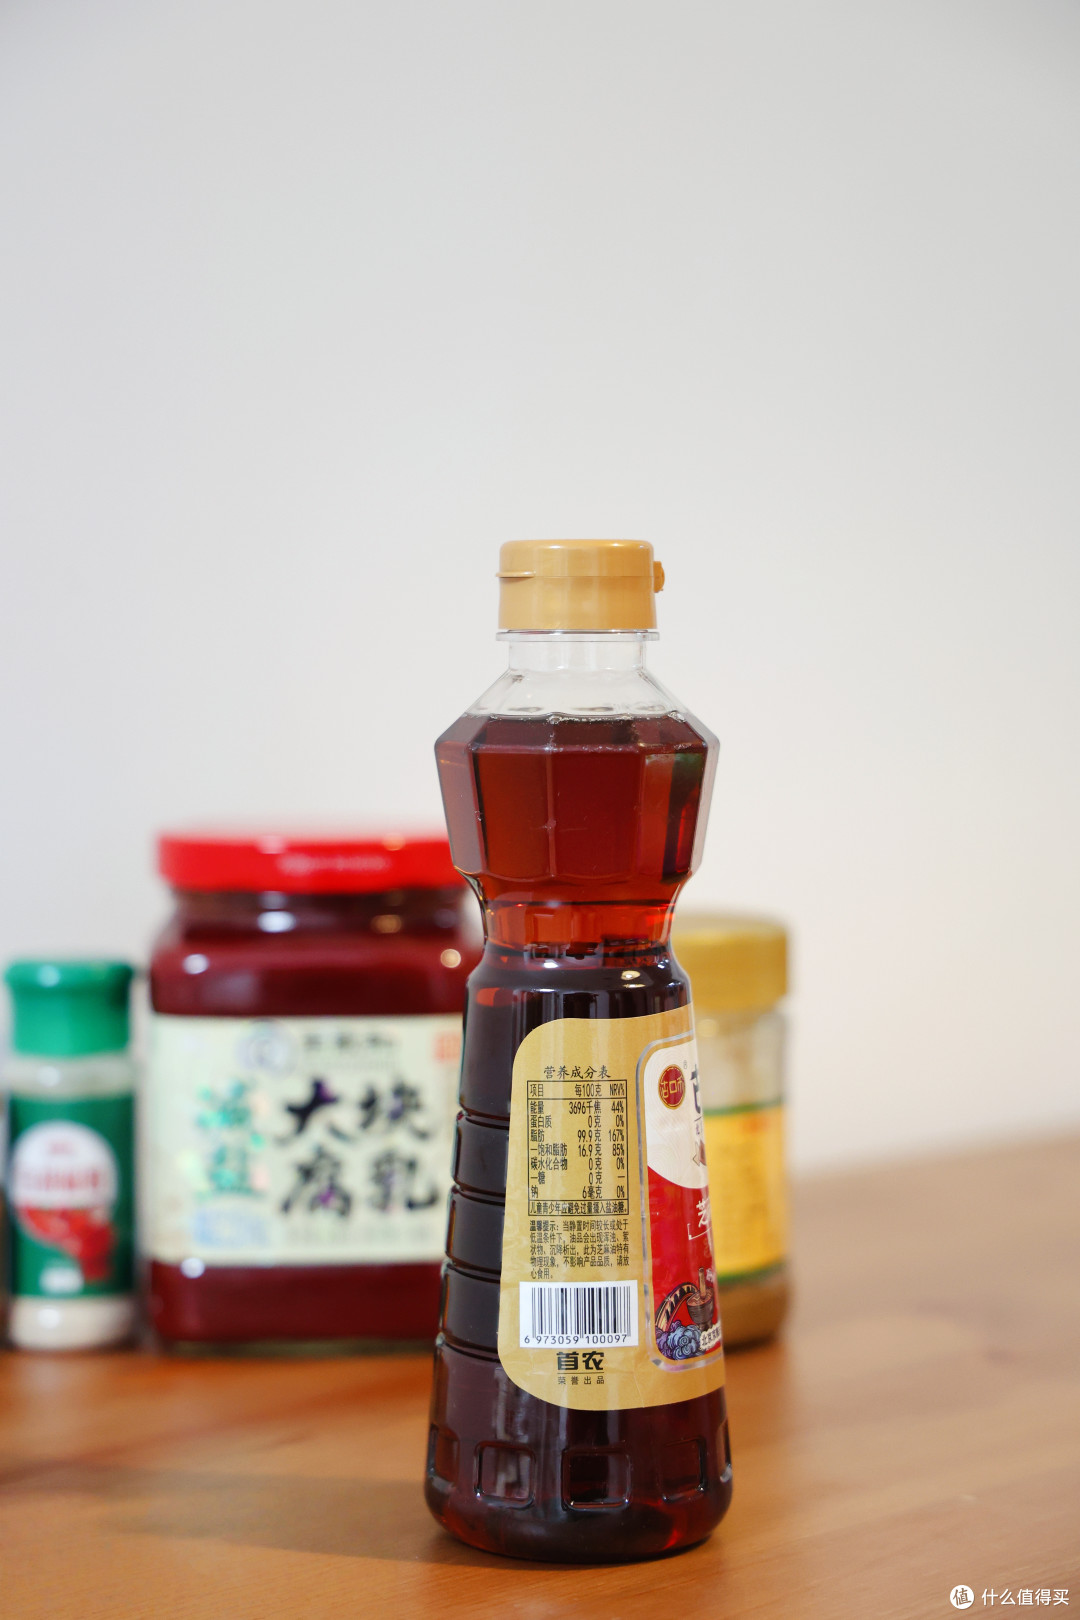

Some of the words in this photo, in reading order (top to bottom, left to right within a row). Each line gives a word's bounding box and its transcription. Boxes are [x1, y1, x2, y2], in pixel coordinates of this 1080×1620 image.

[543, 1064, 611, 1080] 营养成分表
[530, 1083, 544, 1097] 项目
[574, 1083, 602, 1097] 每100克
[609, 1083, 625, 1097] NRV%
[530, 1100, 545, 1114] 能量
[568, 1100, 602, 1114] 3696千焦
[611, 1100, 624, 1113] 44%
[530, 1114, 552, 1128] 蛋白质
[615, 1114, 625, 1127] 0%
[530, 1128, 545, 1142] 脂肪
[608, 1129, 625, 1142] 167%
[612, 1143, 625, 1157] 85%
[530, 1157, 568, 1171] 碳水化合物
[616, 1157, 625, 1170] 0%
[530, 1185, 539, 1198] 钠
[582, 1185, 603, 1199] 6毫克
[616, 1185, 625, 1198] 0%
[530, 1267, 554, 1280] 心食用。
[524, 1335, 530, 1344] 6
[536, 1335, 579, 1344] 973059
[585, 1334, 627, 1344] 100097
[556, 1351, 605, 1370] 首农
[557, 1375, 605, 1386] 荣誉出品
